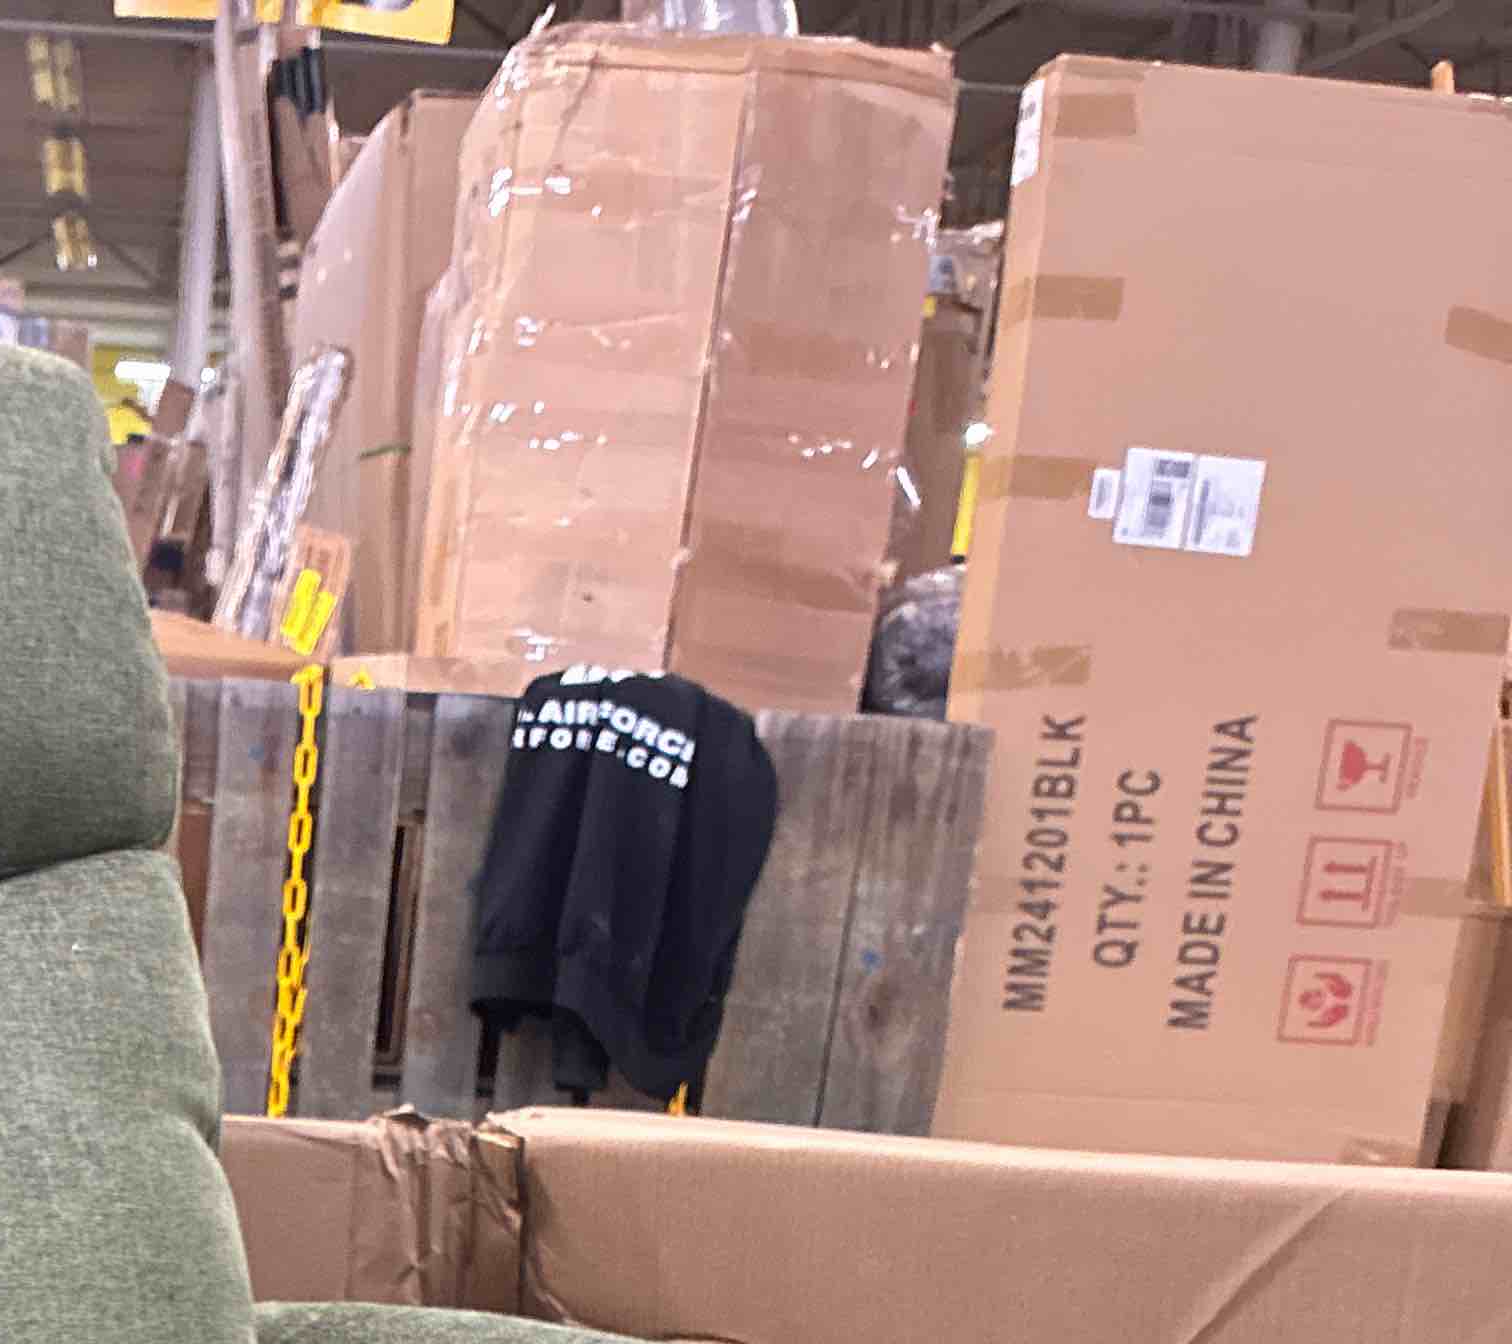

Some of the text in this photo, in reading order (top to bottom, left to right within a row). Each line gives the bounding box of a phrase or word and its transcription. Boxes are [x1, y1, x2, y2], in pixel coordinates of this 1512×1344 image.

[1001, 714, 1086, 1012] MM241201BLK
[1109, 769, 1161, 848] 1PC
[1165, 714, 1258, 1030] MADE IN CHINA
